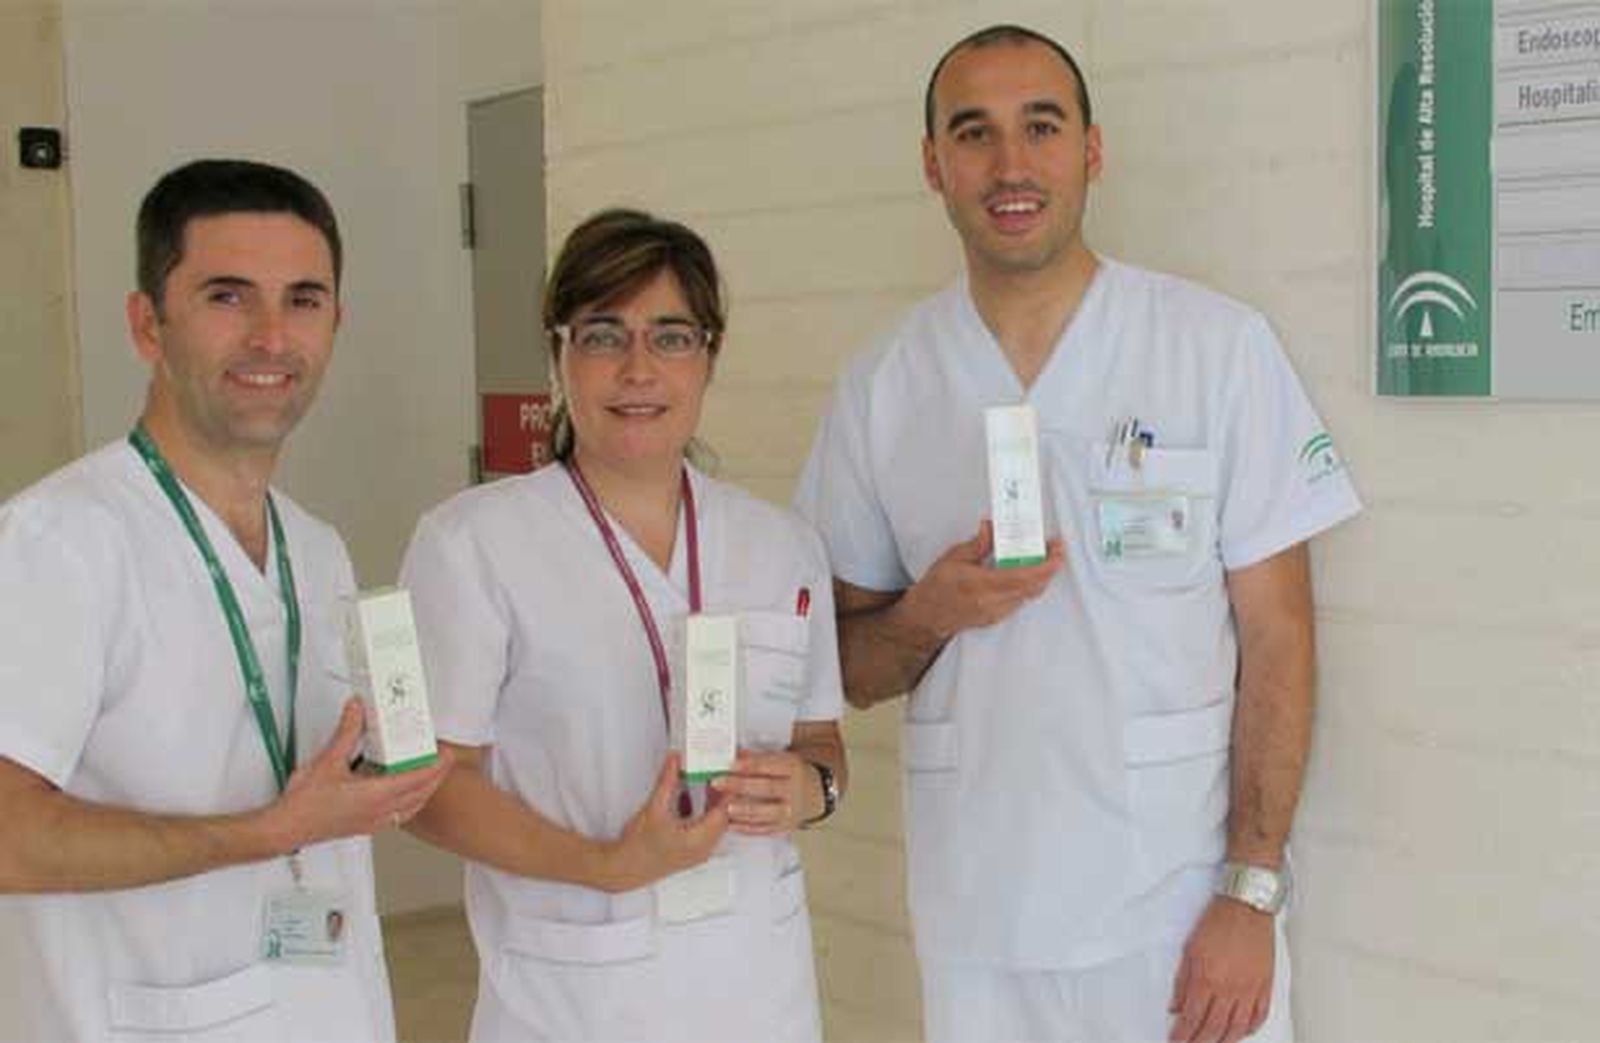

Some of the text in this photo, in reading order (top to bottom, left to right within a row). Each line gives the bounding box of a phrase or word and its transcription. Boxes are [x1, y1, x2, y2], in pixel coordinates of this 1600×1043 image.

[1417, 91, 1434, 124] Alta
[1418, 129, 1434, 151] de
[1417, 154, 1435, 228] Hospital
